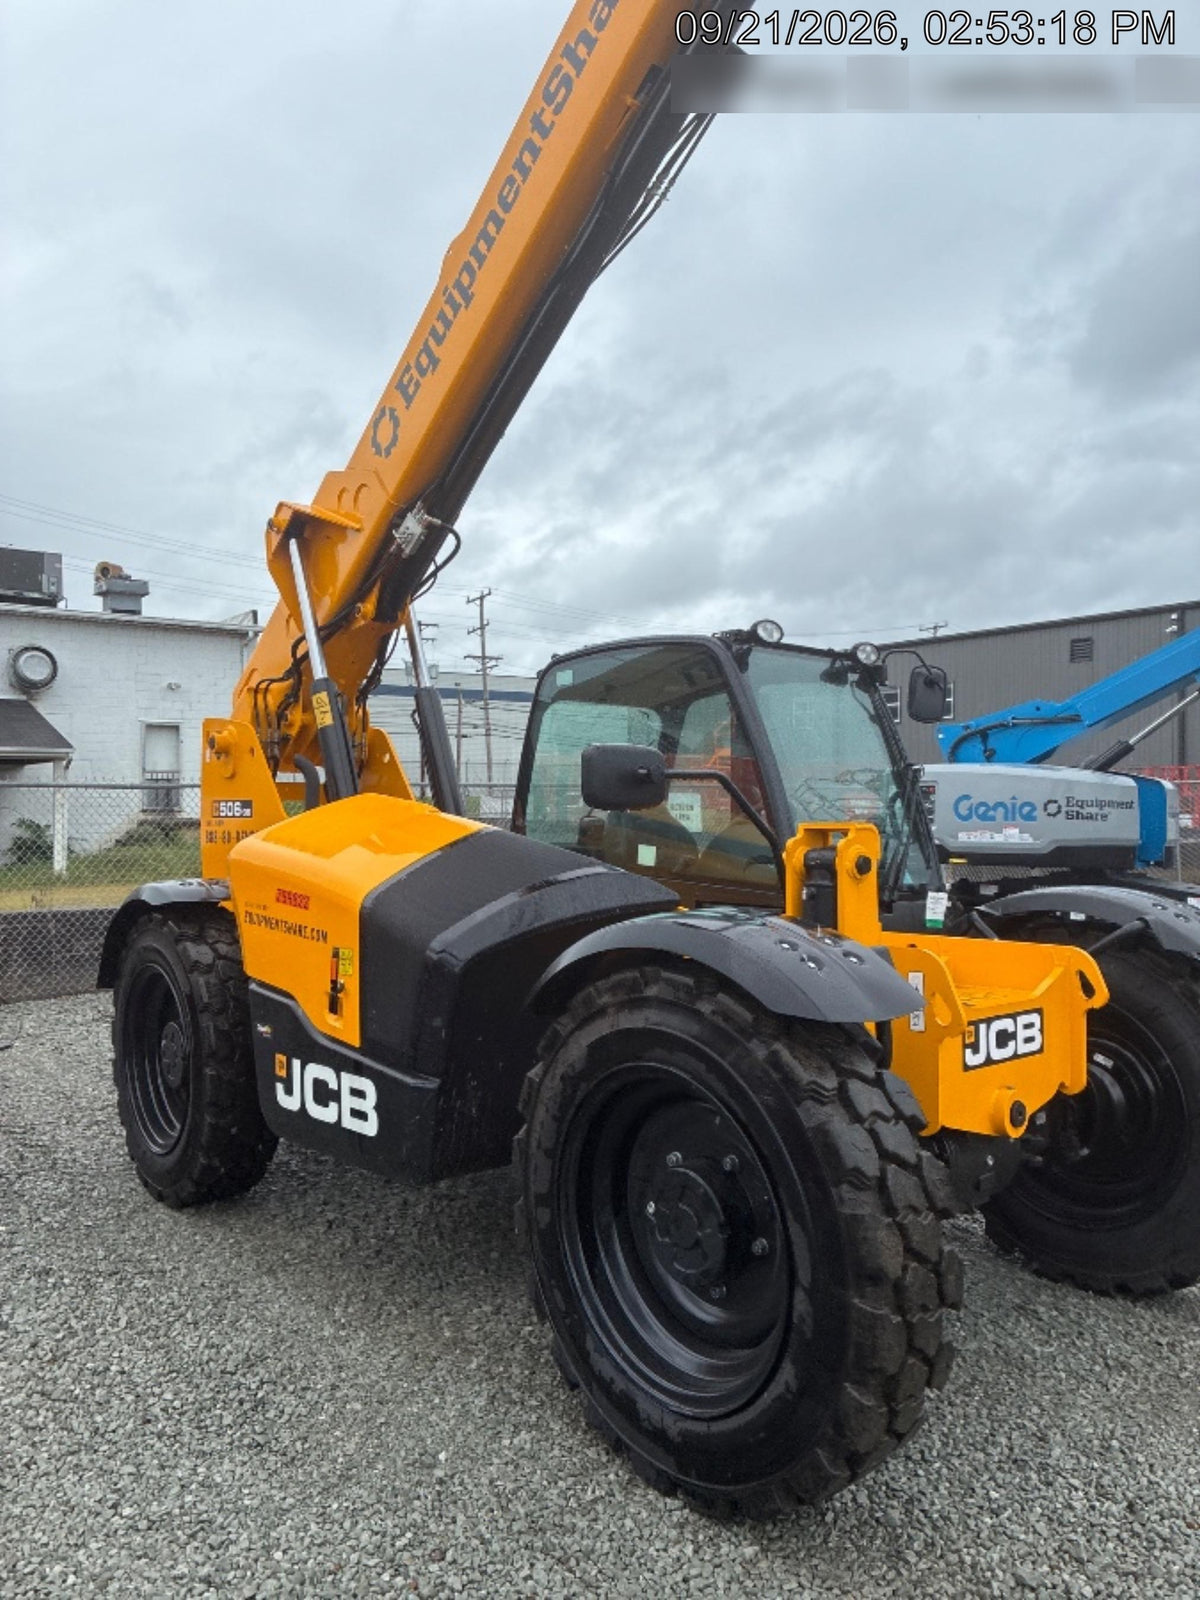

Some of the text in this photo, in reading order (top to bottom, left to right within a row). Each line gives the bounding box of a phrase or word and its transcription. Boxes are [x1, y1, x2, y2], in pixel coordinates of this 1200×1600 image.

[953, 794, 1038, 822] Genie
[1065, 796, 1135, 810] Equipment
[1065, 810, 1109, 822] Share
[964, 1012, 1044, 1067] JCB
[275, 1058, 380, 1138] JCB
